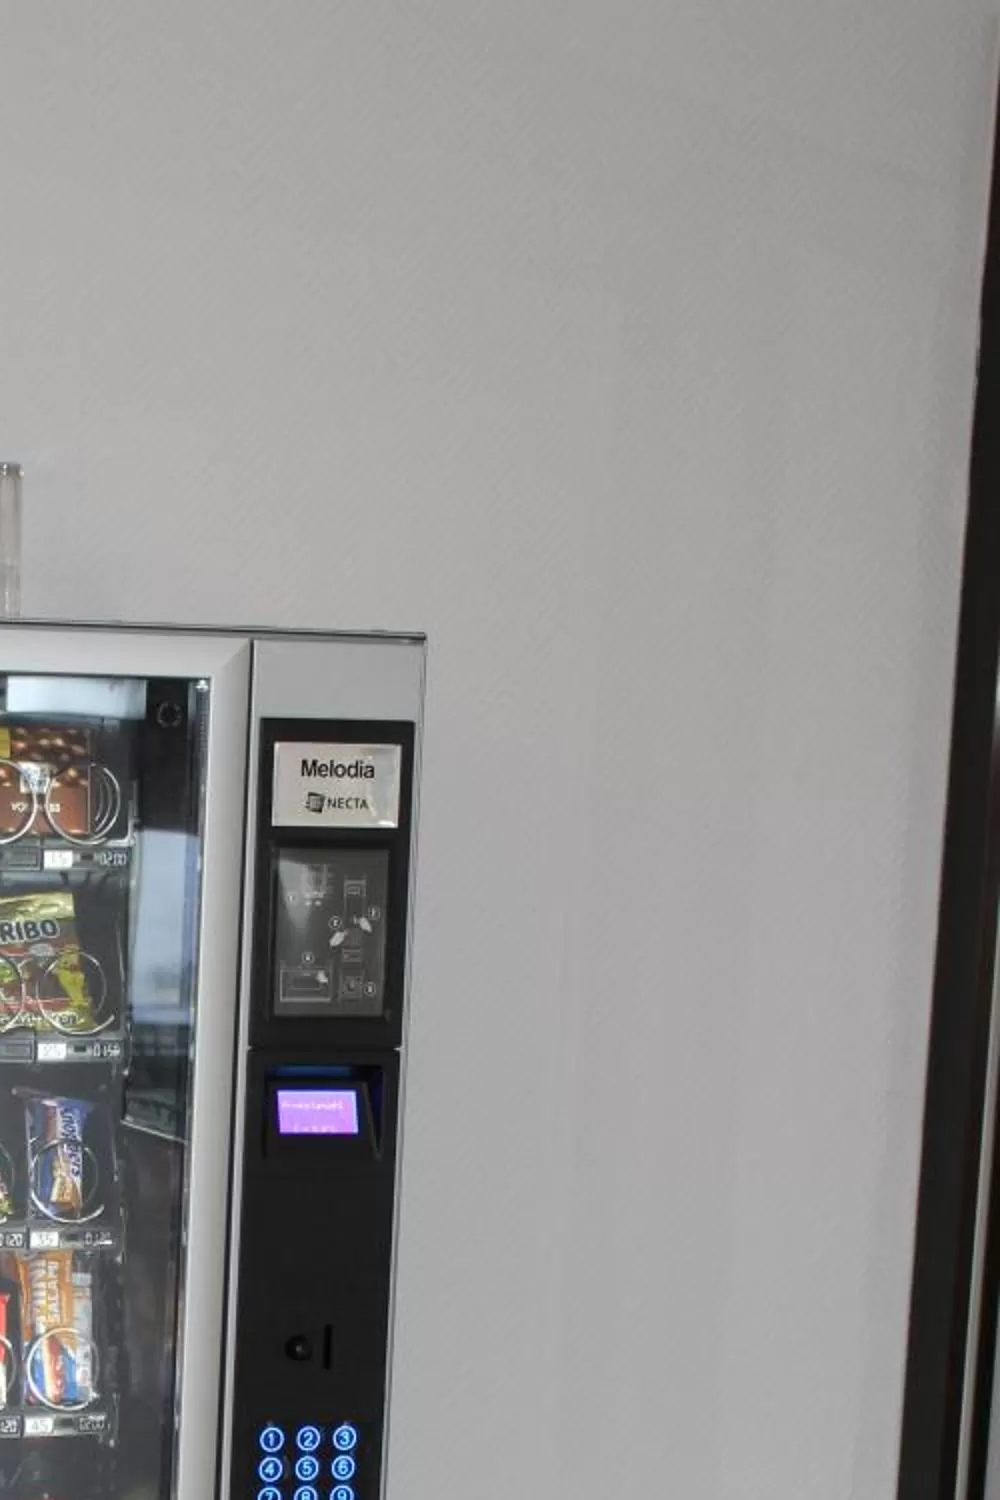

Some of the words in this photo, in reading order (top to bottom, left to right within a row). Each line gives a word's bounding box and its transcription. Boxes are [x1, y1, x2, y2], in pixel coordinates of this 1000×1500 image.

[301, 759, 375, 778] Melodia
[327, 797, 368, 809] NECTA
[268, 1432, 275, 1447] 1
[303, 1431, 314, 1446] 2
[339, 1430, 349, 1445] 3
[264, 1461, 274, 1476] 4
[302, 1461, 312, 1476] 5
[338, 1460, 348, 1475] 6
